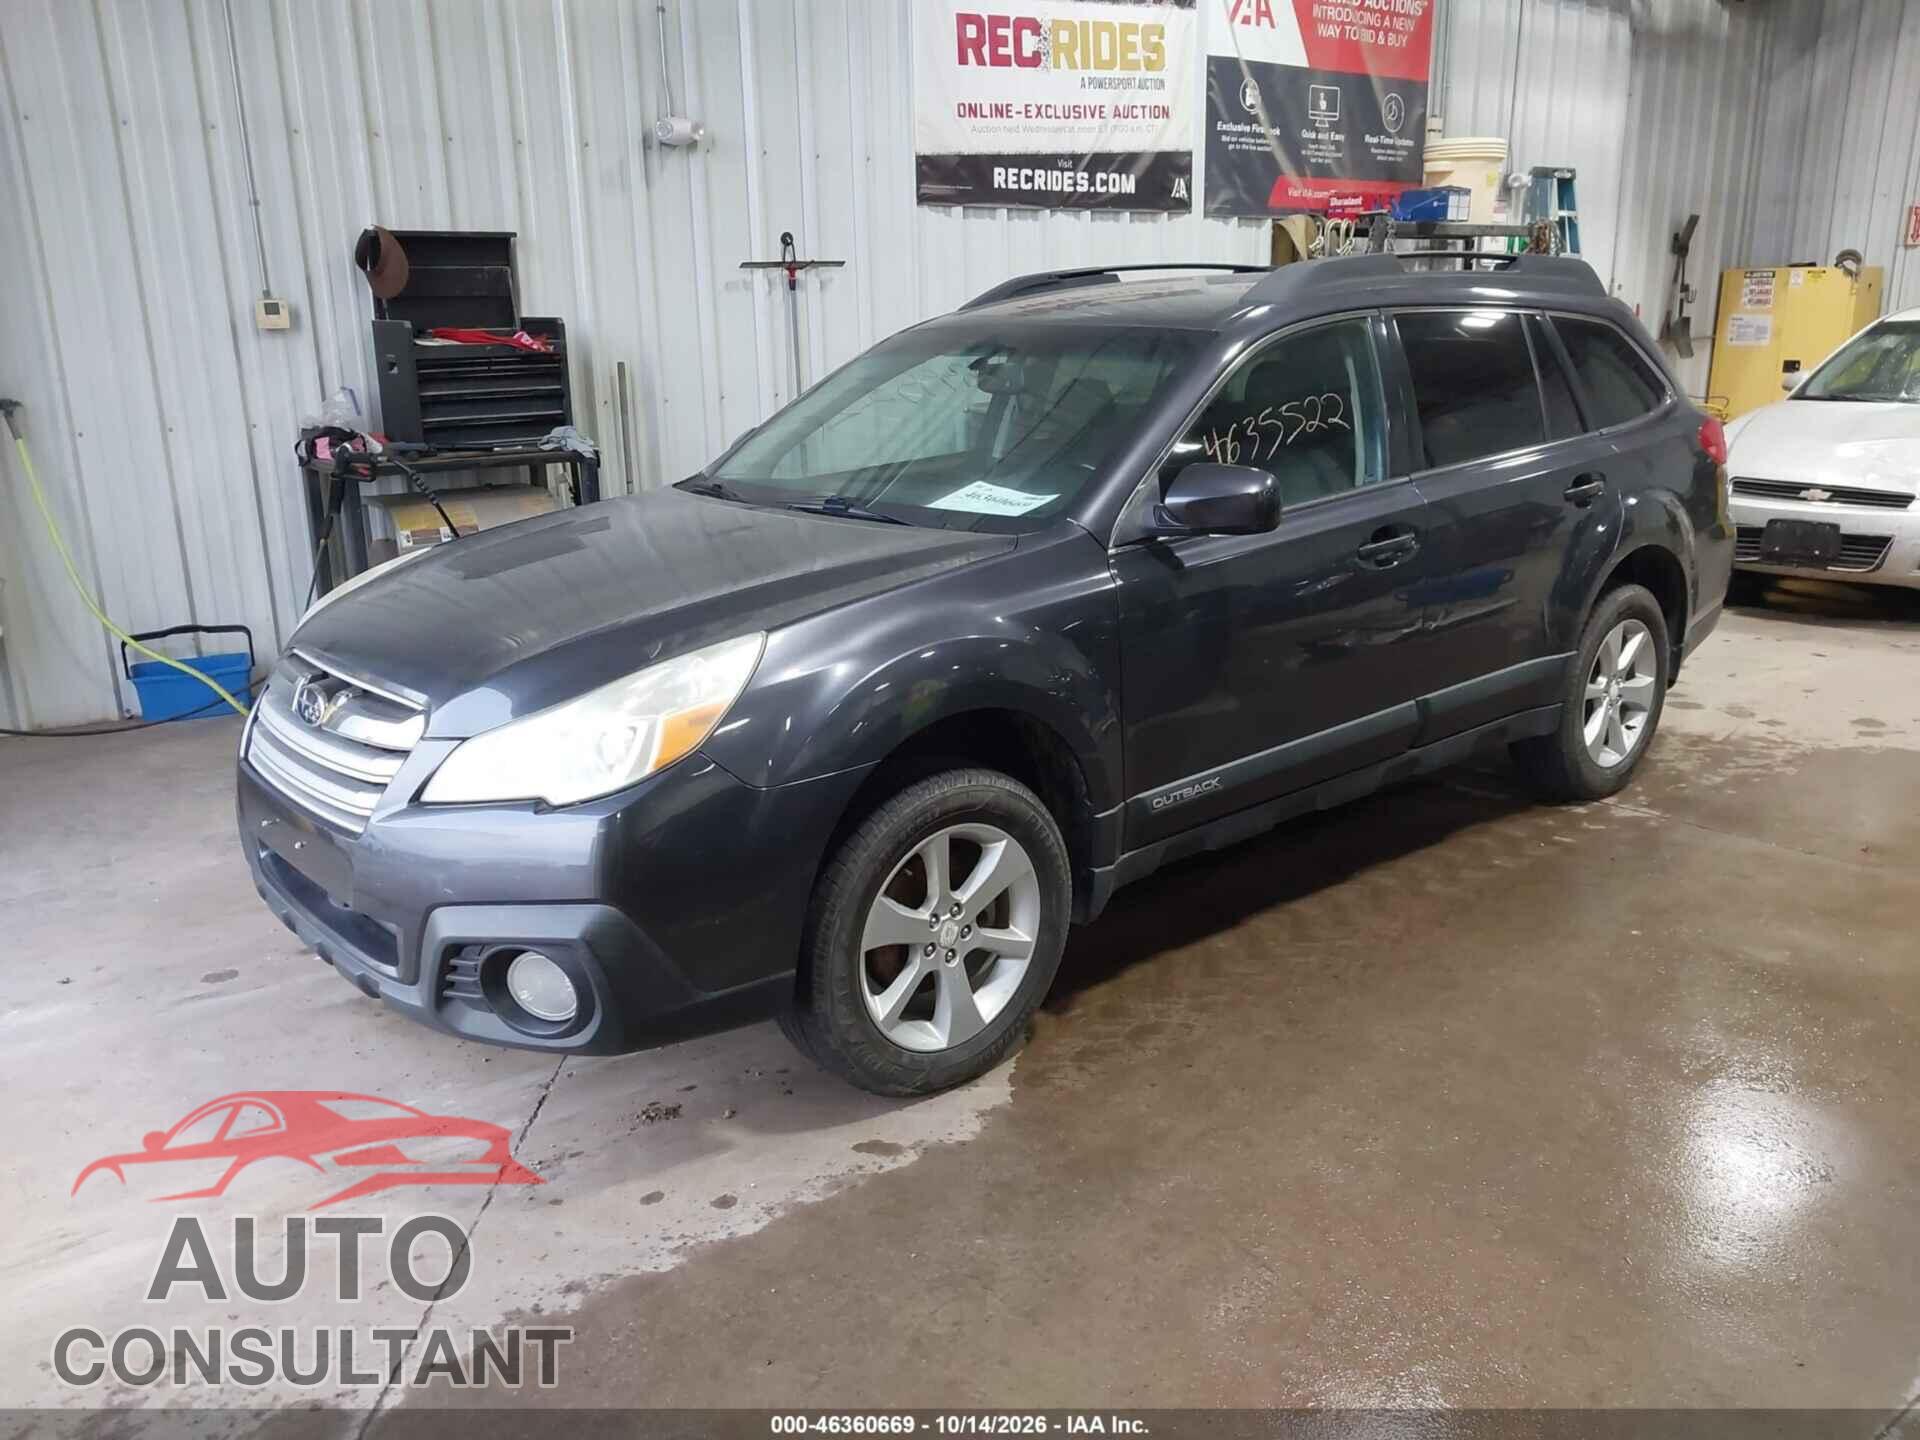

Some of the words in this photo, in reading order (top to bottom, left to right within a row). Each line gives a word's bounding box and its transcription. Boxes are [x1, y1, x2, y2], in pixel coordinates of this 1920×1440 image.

[1312, 4, 1381, 27] INTRODUCING
[1383, 17, 1391, 29] A
[1392, 18, 1416, 31] NEW
[1317, 23, 1342, 39] WAY
[1344, 26, 1359, 40] TO
[1360, 28, 1376, 42] BID
[1378, 31, 1385, 45] &
[1387, 33, 1408, 47] BUY
[1080, 77, 1087, 89] A
[1088, 77, 1136, 90] POWERSPORT
[1138, 78, 1165, 90] AUCTION
[957, 102, 1106, 119] ONLINE-EXCLUSIVE
[1113, 104, 1170, 119] AUCTION
[1216, 120, 1251, 133] Exclusive
[1057, 159, 1073, 169] Visit
[993, 167, 1136, 194] RECRIDES.COM
[1203, 392, 1351, 464] 4635522
[1152, 776, 1221, 808] OUTBACK
